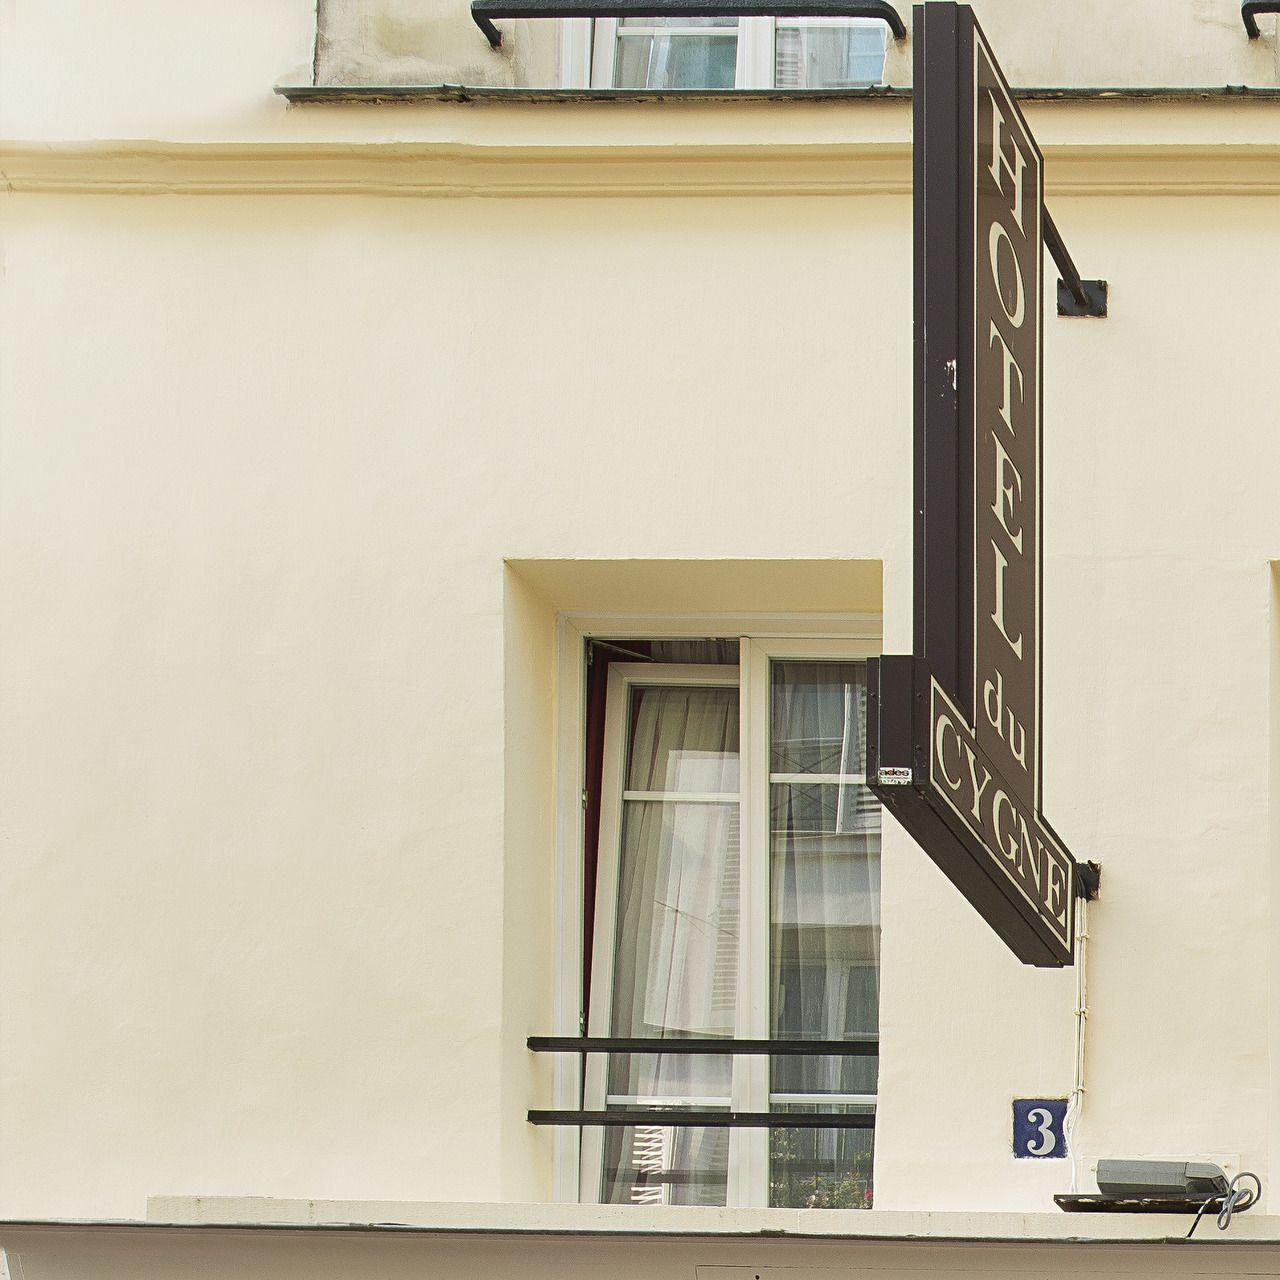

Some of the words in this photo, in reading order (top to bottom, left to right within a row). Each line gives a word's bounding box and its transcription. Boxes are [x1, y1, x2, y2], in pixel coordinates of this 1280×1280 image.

[987, 89, 1028, 661] HOTEL
[983, 665, 1028, 772] du
[935, 714, 1067, 929] CYGNE
[1027, 1108, 1056, 1156] 3
